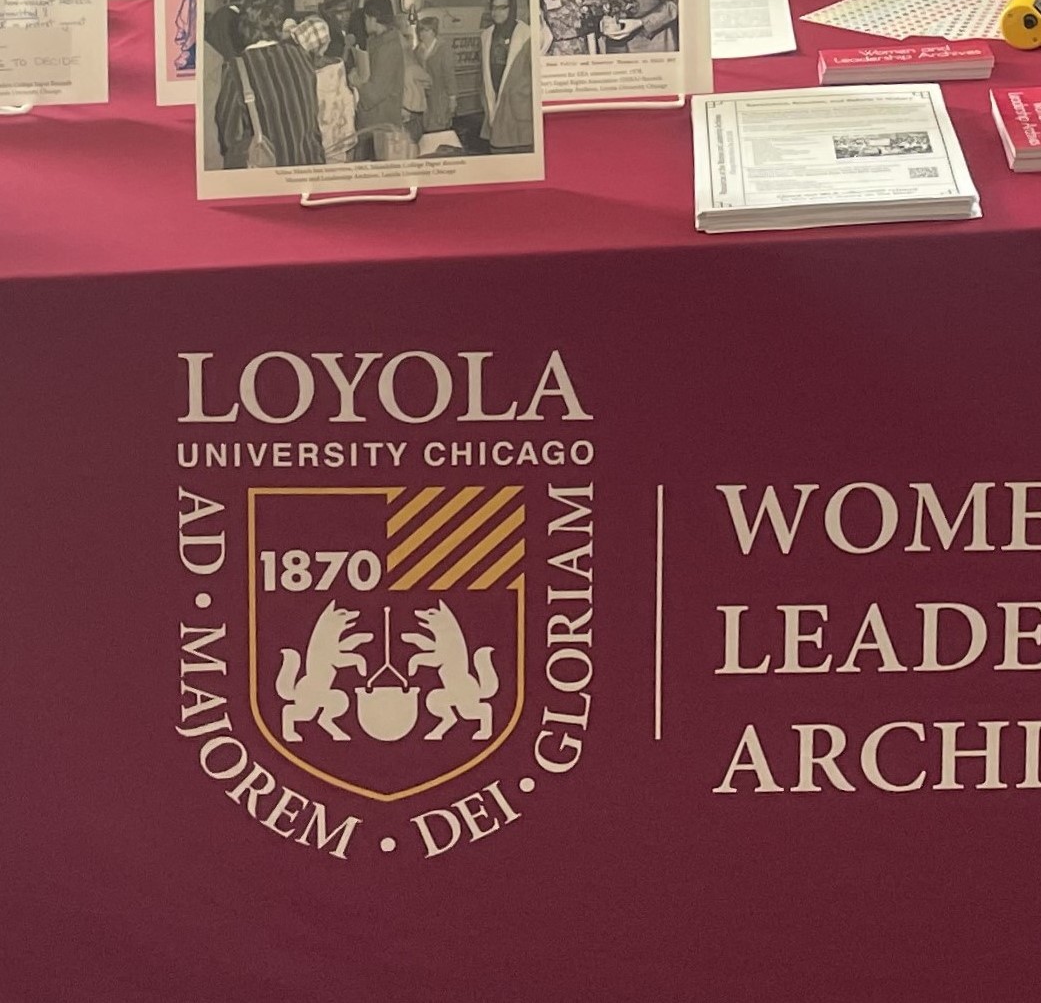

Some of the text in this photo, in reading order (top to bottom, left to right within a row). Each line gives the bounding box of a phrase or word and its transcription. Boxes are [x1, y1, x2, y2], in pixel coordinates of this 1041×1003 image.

[34, 56, 81, 66] DECIDE
[834, 49, 982, 64] Leadership Archives
[858, 44, 950, 56] Women and
[177, 349, 594, 425] LOYOLA
[177, 440, 594, 468] UNIVERSITY CHICAGO
[260, 549, 382, 592] 1870
[175, 481, 594, 860] AD MAJOREM DEI GLORIAM
